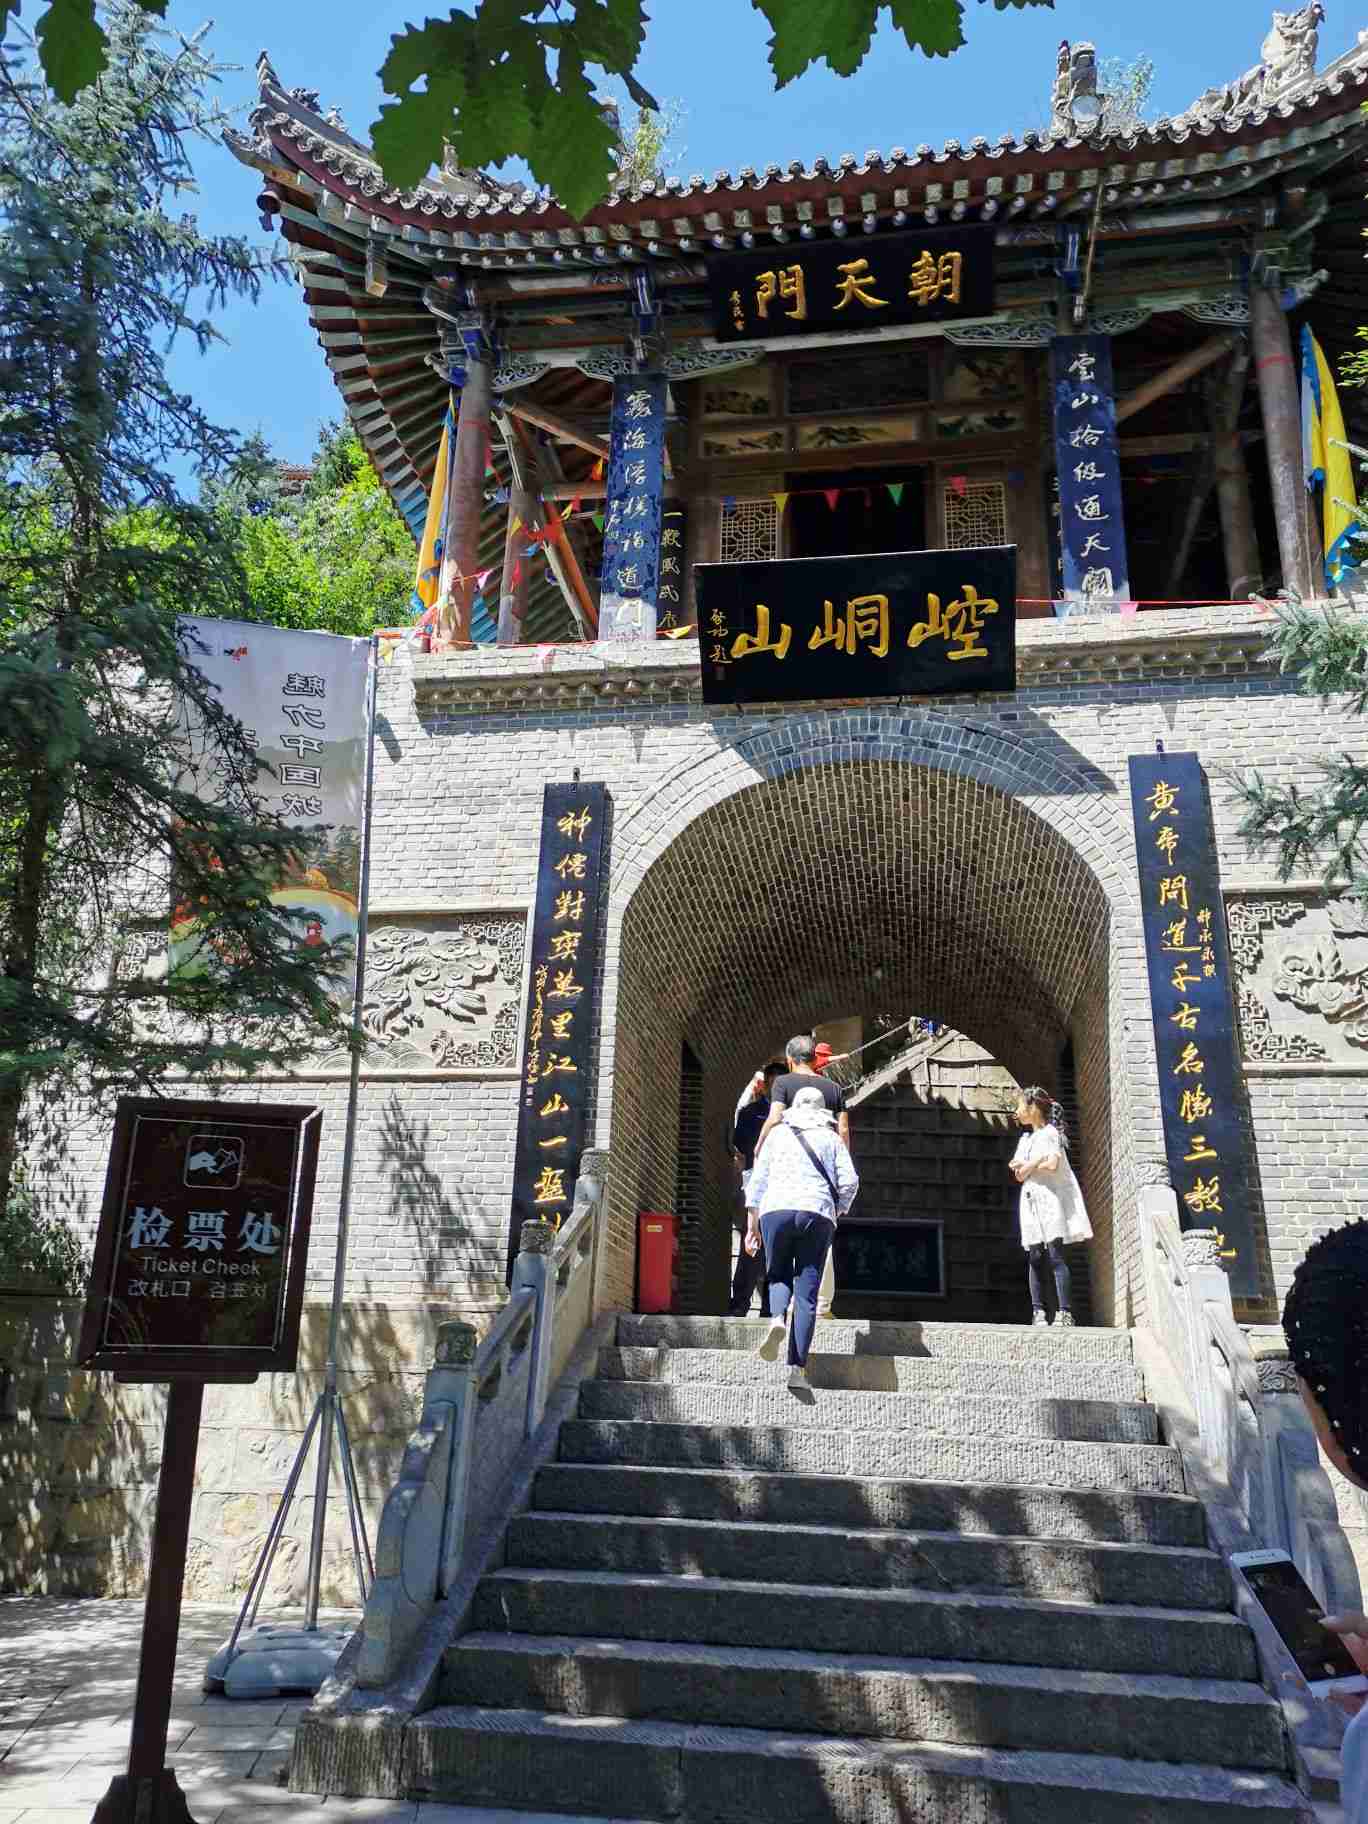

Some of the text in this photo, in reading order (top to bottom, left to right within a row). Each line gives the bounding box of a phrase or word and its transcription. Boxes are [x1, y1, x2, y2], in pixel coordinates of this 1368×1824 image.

[755, 250, 963, 320] 朝天門
[731, 585, 999, 660] 崆峒山
[127, 1206, 280, 1254] 检票处
[127, 1279, 192, 1298] 改札口
[142, 1257, 261, 1276] Ticket Check
